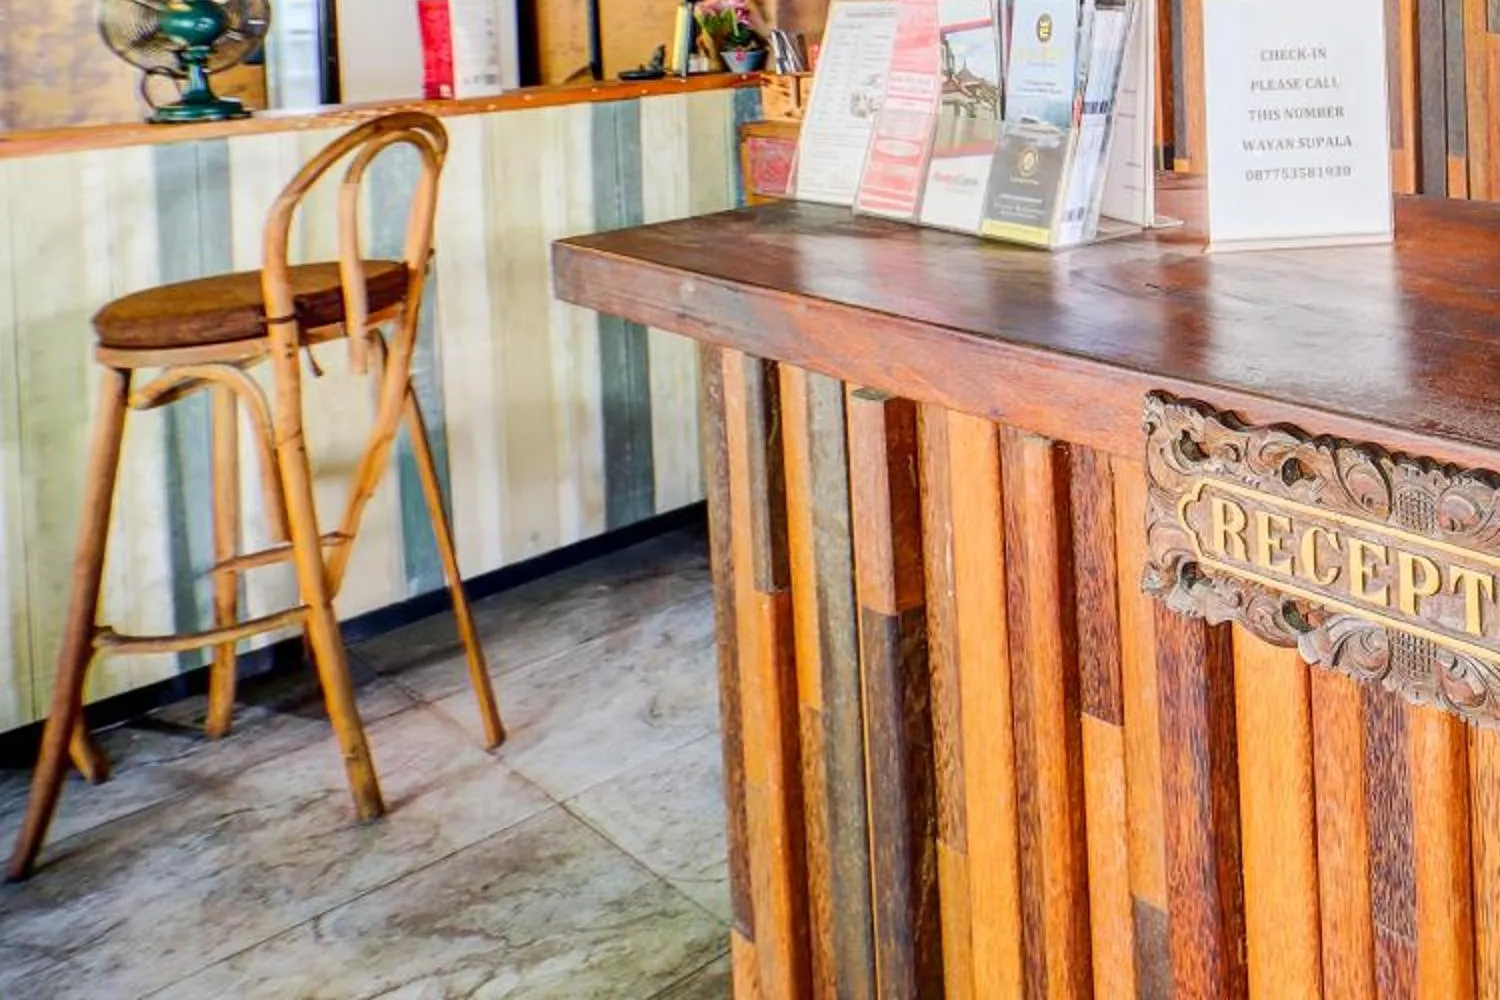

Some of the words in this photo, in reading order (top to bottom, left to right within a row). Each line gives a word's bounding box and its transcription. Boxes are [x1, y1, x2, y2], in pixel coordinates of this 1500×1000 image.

[1260, 47, 1327, 62] CHECK-IN
[1250, 77, 1303, 92] PLEASE
[1305, 76, 1340, 90] CALL
[1248, 109, 1281, 122] THIS
[1284, 105, 1345, 120] NUMBER
[1242, 138, 1295, 151] WAYAN
[1297, 135, 1353, 148] SUPALA
